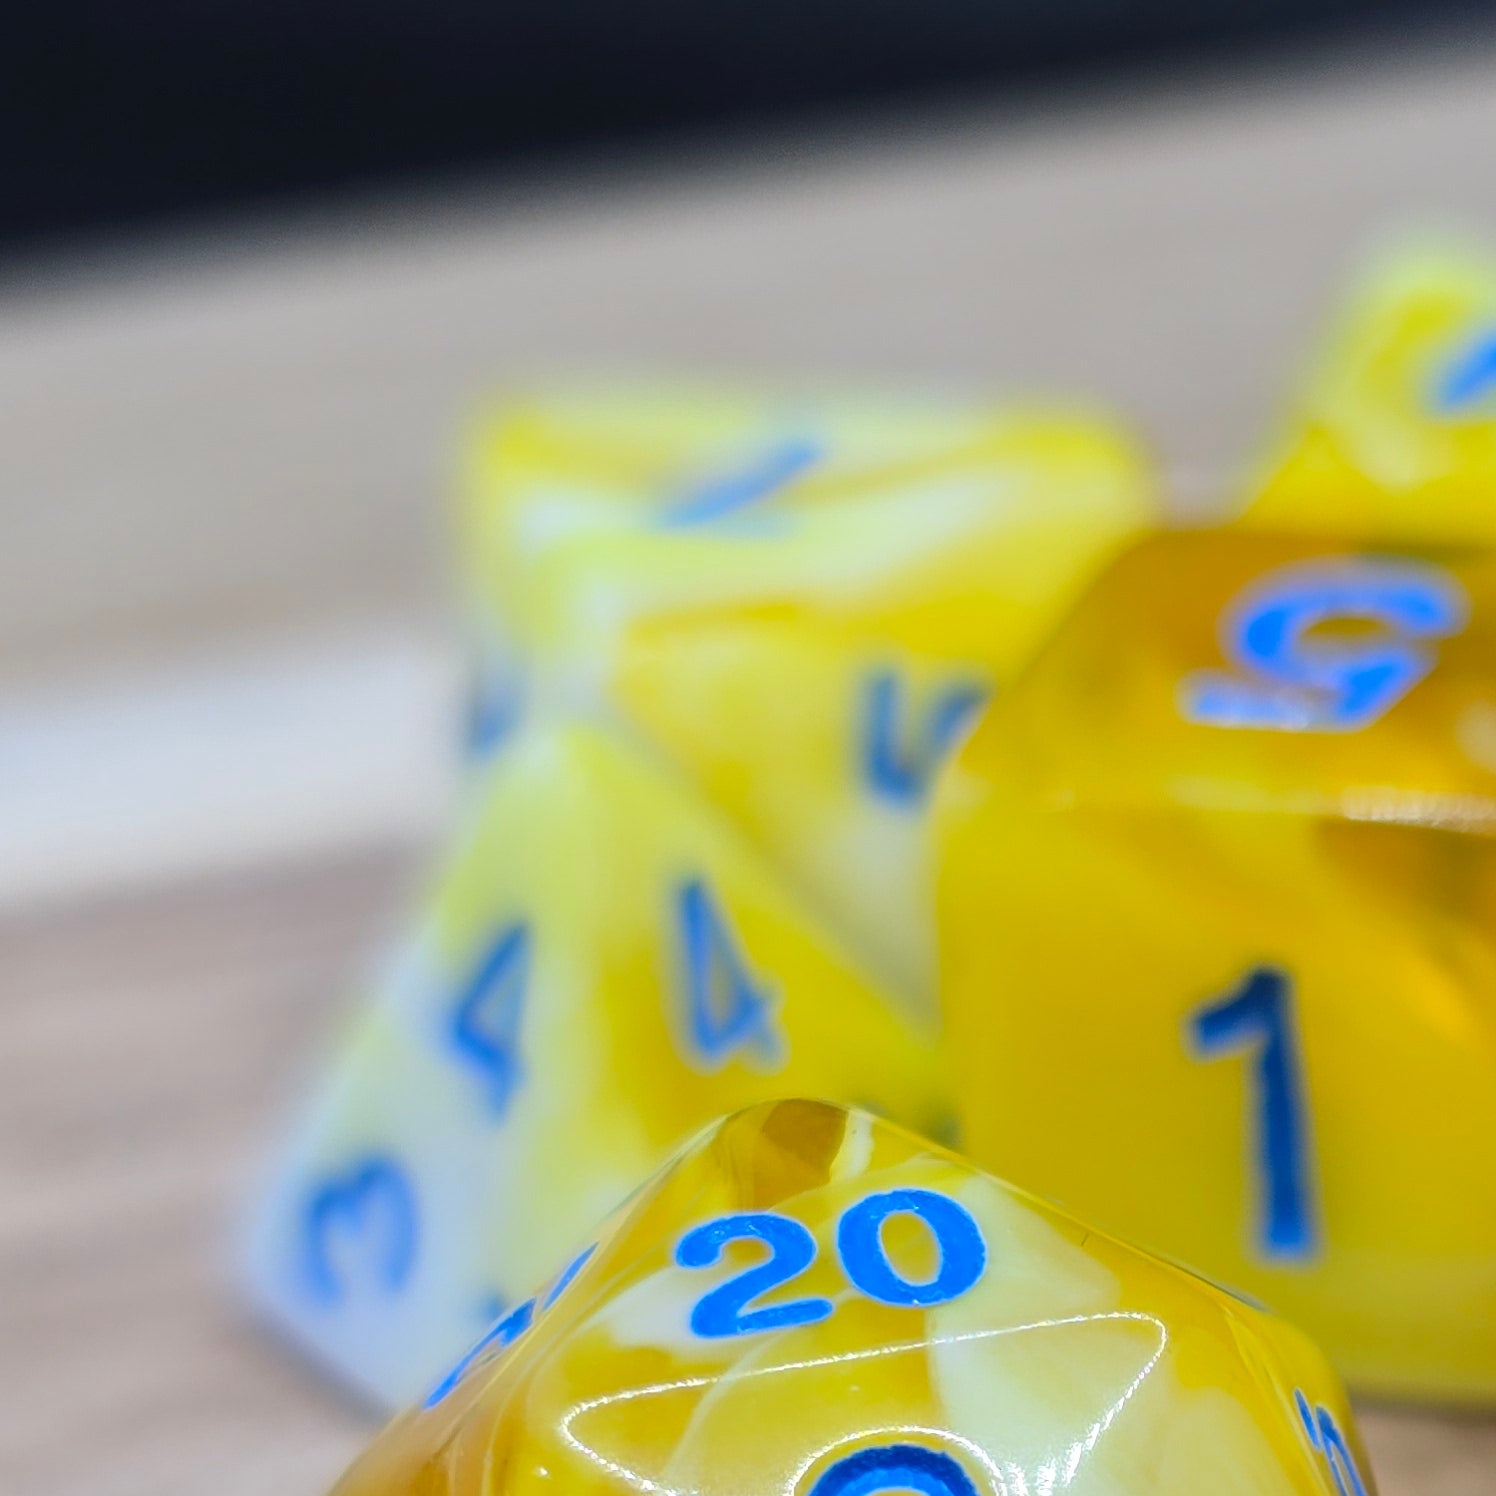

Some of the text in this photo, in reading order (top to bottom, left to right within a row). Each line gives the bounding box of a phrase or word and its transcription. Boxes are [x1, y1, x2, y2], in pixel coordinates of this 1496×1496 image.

[1185, 560, 1462, 728] 5
[675, 880, 778, 1070] 4
[1190, 965, 1316, 1262] 1
[673, 1187, 989, 1341] 20
